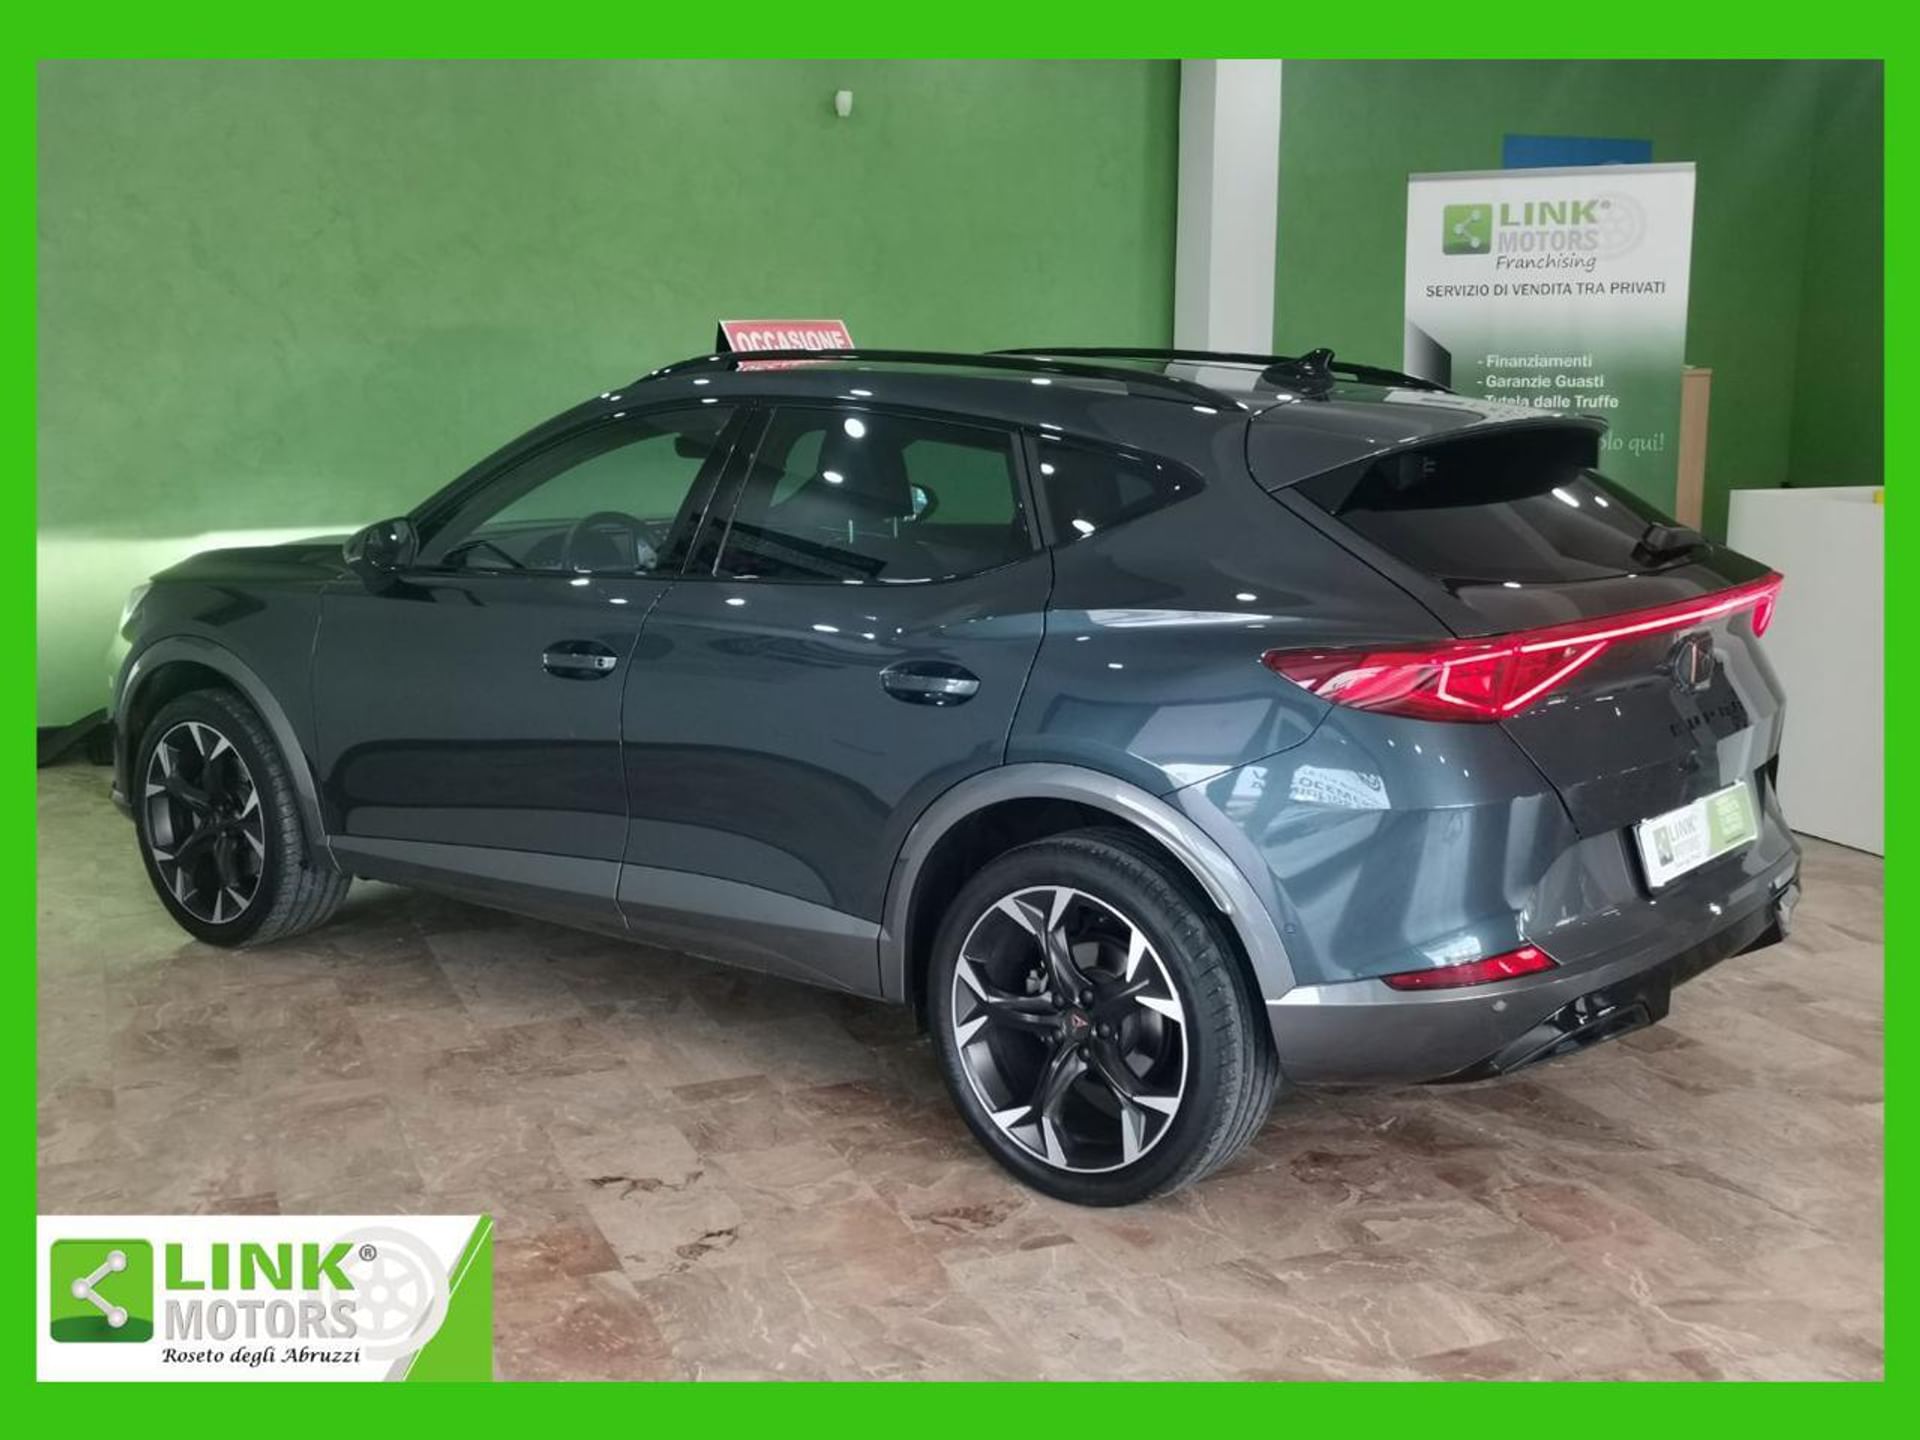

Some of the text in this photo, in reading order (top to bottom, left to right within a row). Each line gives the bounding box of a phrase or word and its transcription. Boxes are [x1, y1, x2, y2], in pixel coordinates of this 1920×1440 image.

[1500, 200, 1599, 227] LINK
[1500, 230, 1599, 252] MOTORS
[1496, 253, 1597, 272] Franchising
[1426, 281, 1666, 297] SERVIZIO DI VENDITA TRA PRIVATI
[735, 330, 847, 352] OCCASIONE
[1486, 354, 1593, 369] Finanziamenti
[1486, 375, 1605, 389] Garanzie Guasti
[1533, 394, 1571, 409] dalle
[1574, 394, 1620, 409] Truffe
[1598, 430, 1665, 457] olo qui!
